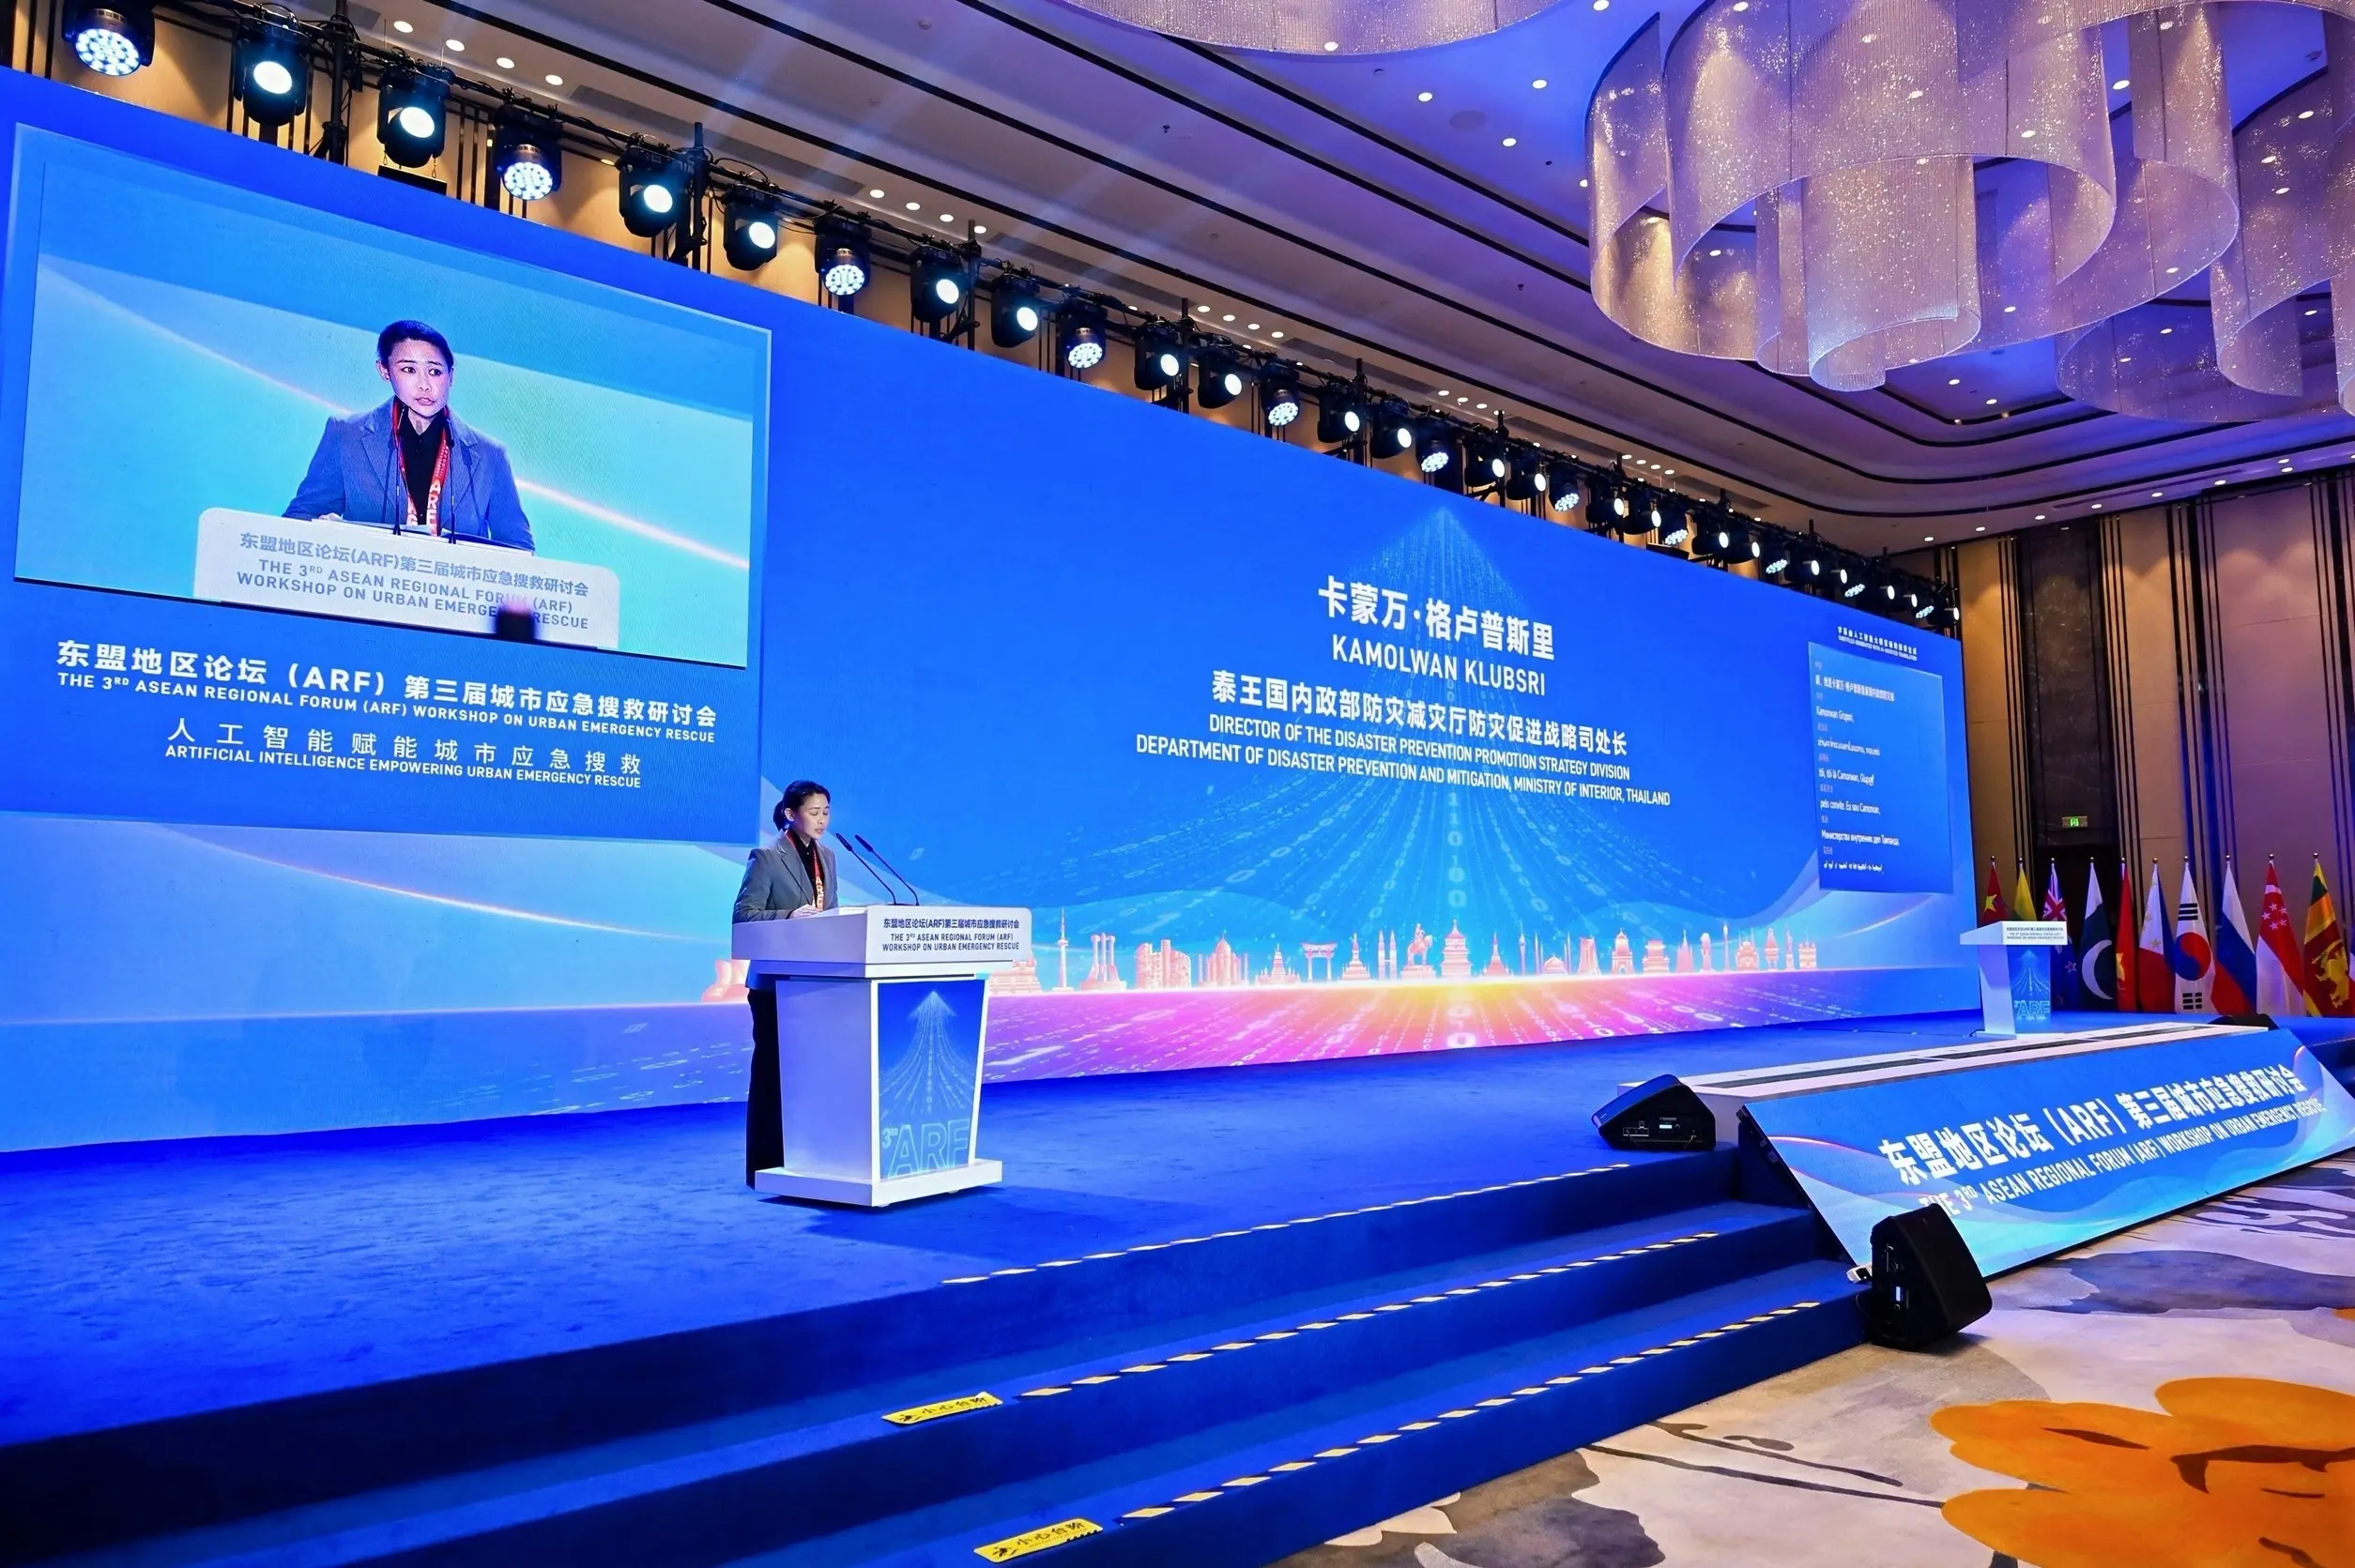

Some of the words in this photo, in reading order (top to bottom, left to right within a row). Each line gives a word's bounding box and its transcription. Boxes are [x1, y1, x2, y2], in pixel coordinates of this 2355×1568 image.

[240, 533, 589, 597] 东盟地区论坛(ARF)第三届城市应急搜救研讨会
[259, 559, 292, 575] THE
[299, 565, 323, 577] 3RD
[329, 570, 384, 587] ASEAN
[391, 578, 469, 600] REGIONAL
[533, 597, 573, 614] (ARF)
[237, 571, 337, 595] WORKSHOP
[344, 586, 366, 600] ON
[373, 590, 429, 608] URBAN
[435, 599, 505, 618] EMERGE
[533, 612, 589, 629] RESCUE
[1318, 574, 1554, 661] 卡蒙万·格卢普斯里
[56, 640, 267, 685] 东盟地区论坛
[405, 675, 716, 727] 第三届城市应急搜救研讨会
[1332, 633, 1458, 680] KAMOLWAN
[1465, 659, 1545, 696] KLUBSRI
[58, 673, 94, 688] THE
[102, 677, 130, 691] 3RD
[135, 680, 197, 697] ASEAN
[205, 686, 293, 706] REGIONAL
[300, 694, 357, 711] FORUM
[363, 699, 406, 717] (ARF)
[413, 705, 498, 723] WORKSHOP
[503, 714, 523, 726] ON
[528, 716, 576, 732] URBAN
[582, 721, 662, 739] EMERGENCY
[665, 728, 715, 743] RESCUE
[1212, 669, 1628, 756] 泰王国内政部防灾减灾厅防灾促进战略司处长
[164, 745, 253, 763] ARTIFICIAL
[259, 751, 364, 770] INTELLIGENCE
[370, 757, 463, 776] EMPOWERING
[466, 766, 512, 780] URBAN
[516, 769, 590, 785] EMERGENCY
[594, 774, 640, 788] RESCUE
[168, 718, 640, 775] 人工智能赋能城市应急搜救
[1136, 734, 1242, 762] DEPARTMENT
[1245, 746, 1264, 765] OF
[1267, 748, 1335, 772] DISASTER
[1338, 756, 1417, 781] PREVENTION
[1419, 765, 1445, 784] AND
[1446, 769, 1512, 792] MITIGATION,
[1514, 776, 1562, 796] MINISTRY
[1565, 782, 1577, 797] OF
[1579, 784, 1625, 803] INTERIOR,
[1626, 788, 1671, 807] THAILAND
[1209, 713, 1280, 740] DIRECTOR
[1285, 723, 1303, 742] OF
[1305, 725, 1331, 746] THE
[1335, 730, 1397, 754] DISASTER
[1399, 738, 1472, 763] PREVENTION
[1476, 750, 1537, 770] PROMOTION
[1538, 756, 1587, 776] STRATEGY
[1590, 763, 1630, 781] DIVISION
[882, 943, 921, 951] WORKSHOP
[958, 942, 994, 951] EMERGENCY
[917, 933, 940, 941] ASEAN
[941, 933, 972, 941] REGIONAL
[974, 933, 995, 941] FORUM
[997, 933, 1014, 941] (ARF)
[888, 1119, 971, 1179] ARF
[1878, 1113, 2054, 1186] 东盟地区论坛
[2115, 1063, 2308, 1131] 第三届城市应急搜救研讨会
[1954, 1185, 1979, 1211] 3RD
[1980, 1174, 2035, 1205] ASEAN
[2026, 1158, 2097, 1191] REGIONAL
[2087, 1146, 2136, 1174] FORUM
[2132, 1139, 2166, 1165] (ARF)
[2157, 1126, 2215, 1155] WORKSHOP
[2210, 1122, 2231, 1140] ON
[2222, 1115, 2260, 1137] URBAN
[2253, 1103, 2302, 1130] EMERGENCY
[2294, 1098, 2328, 1117] RESCUE
[1017, 1521, 1084, 1545] 小心台阶
